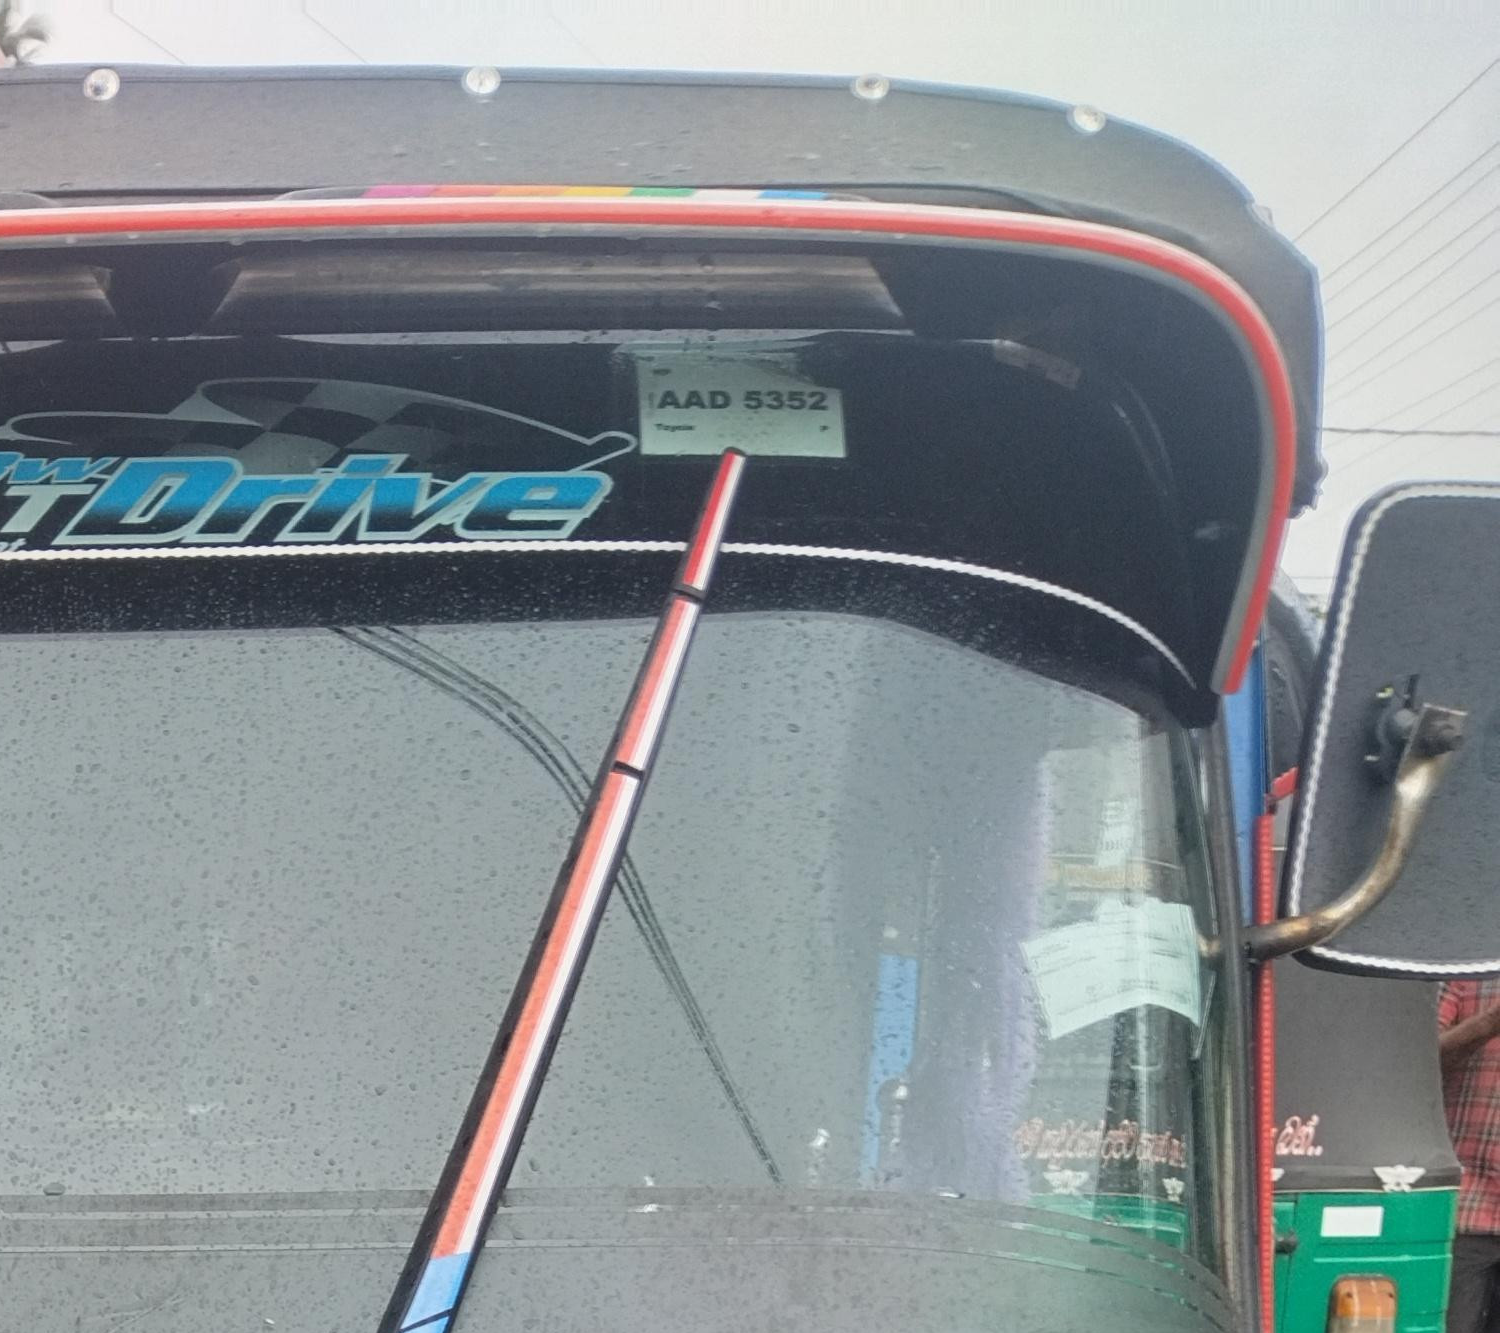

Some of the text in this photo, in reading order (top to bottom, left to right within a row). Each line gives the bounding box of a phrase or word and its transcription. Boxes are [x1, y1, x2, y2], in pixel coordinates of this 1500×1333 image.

[657, 390, 828, 410] AAD 5352
[51, 454, 613, 544] Drive
